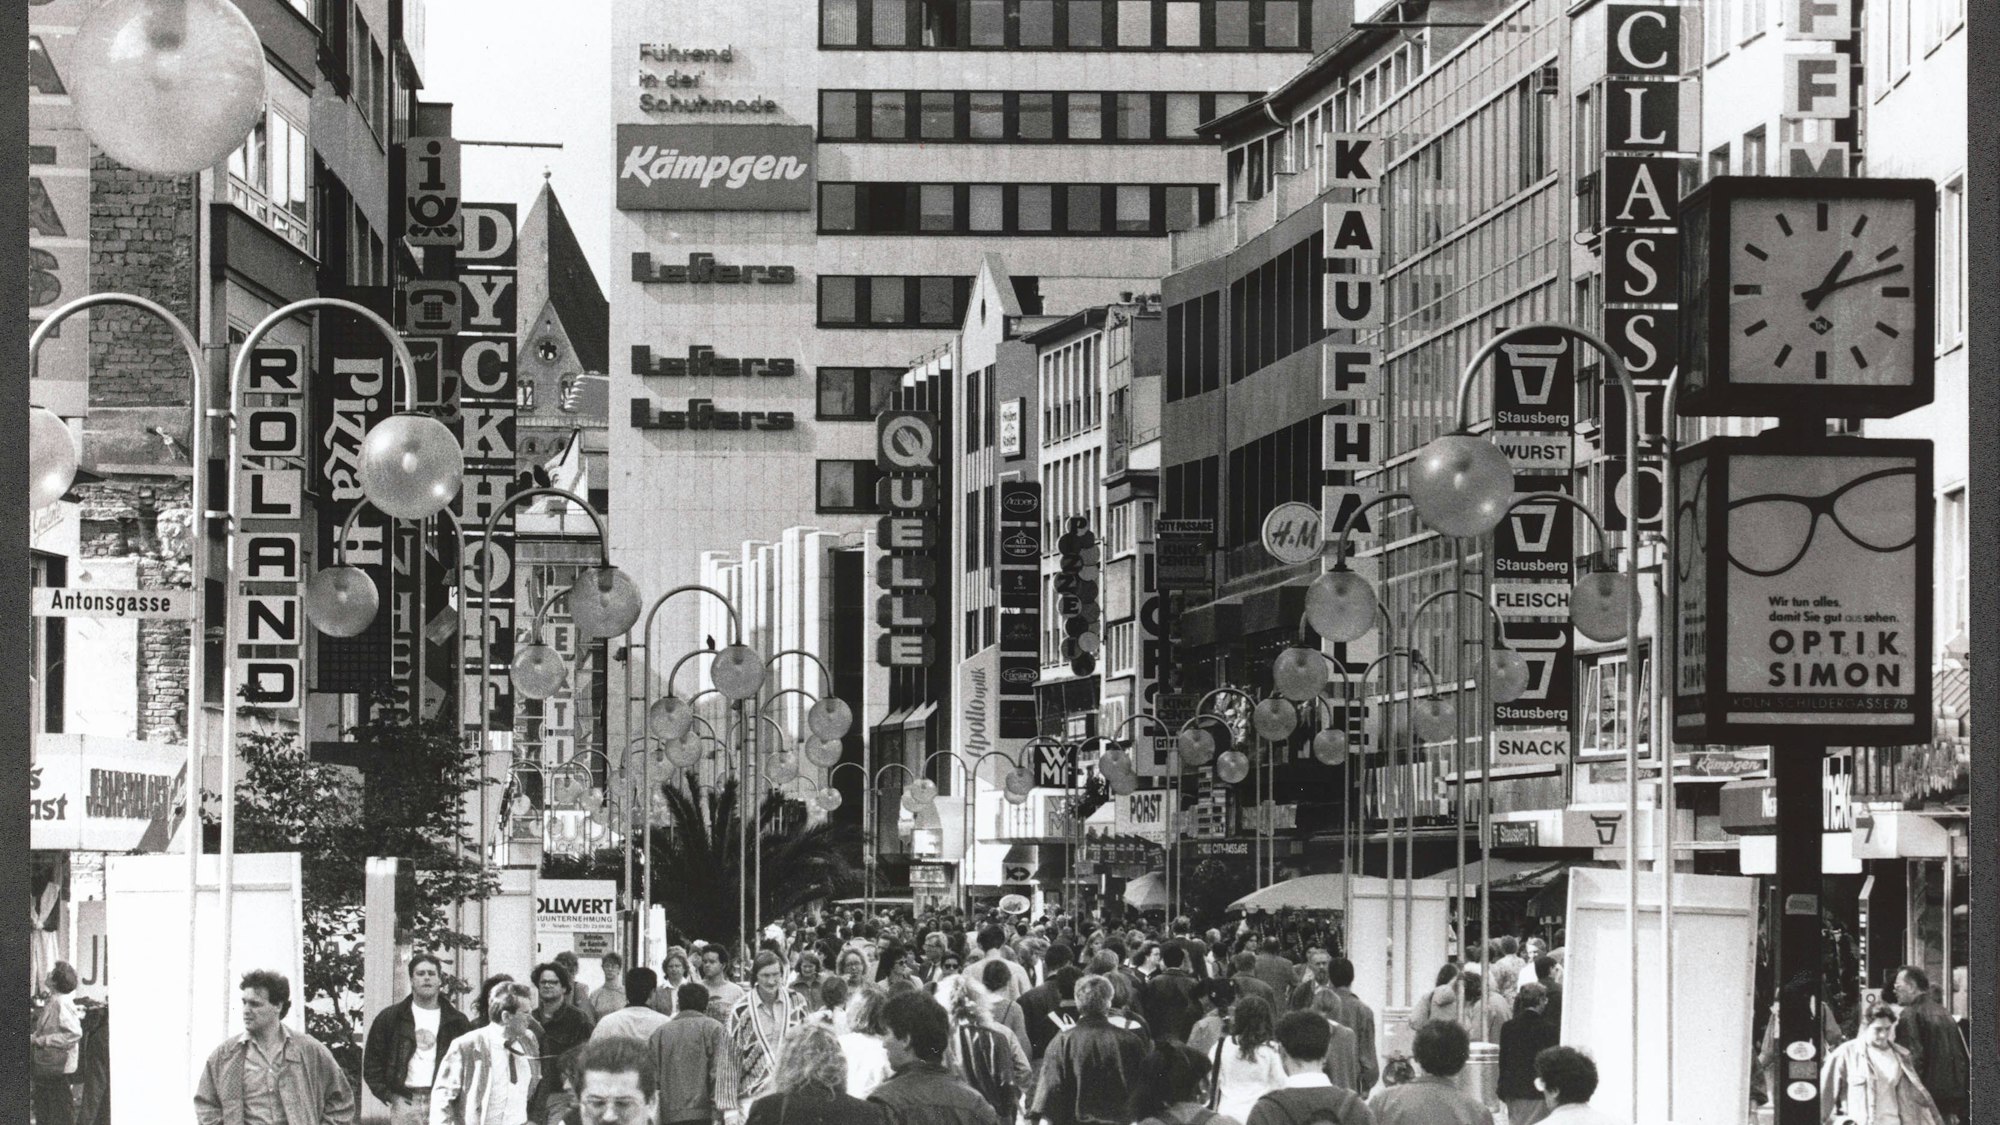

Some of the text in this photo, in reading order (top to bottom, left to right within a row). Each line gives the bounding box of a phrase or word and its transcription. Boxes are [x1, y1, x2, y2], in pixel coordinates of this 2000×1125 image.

[639, 43, 733, 63] Führend
[639, 69, 702, 88] in der
[639, 93, 778, 114] Schuhmode
[620, 145, 808, 189] Kämpgen
[1497, 410, 1570, 427] Stausberg
[1331, 139, 1374, 746] KAUFHALE
[1499, 445, 1567, 460] WURST
[454, 207, 515, 726] DYCKHOFF
[247, 348, 299, 703] ROLAND
[881, 415, 935, 666] QUELLE
[1496, 557, 1569, 575] Stausberg
[51, 589, 171, 617] Antonsgasse
[1496, 592, 1569, 608] FLEISCH
[1768, 596, 1789, 607] Wir
[1792, 596, 1811, 607] tun
[1768, 610, 1801, 622] damit
[1803, 610, 1821, 622] Sie
[1823, 612, 1843, 625] gut
[1768, 629, 1900, 655] OPTIK
[1767, 661, 1901, 687] SIMON
[1496, 706, 1569, 722] Stausberg
[1498, 740, 1567, 756] SNACK
[1696, 755, 1761, 774] Kämpgen
[1129, 794, 1162, 823] PORST
